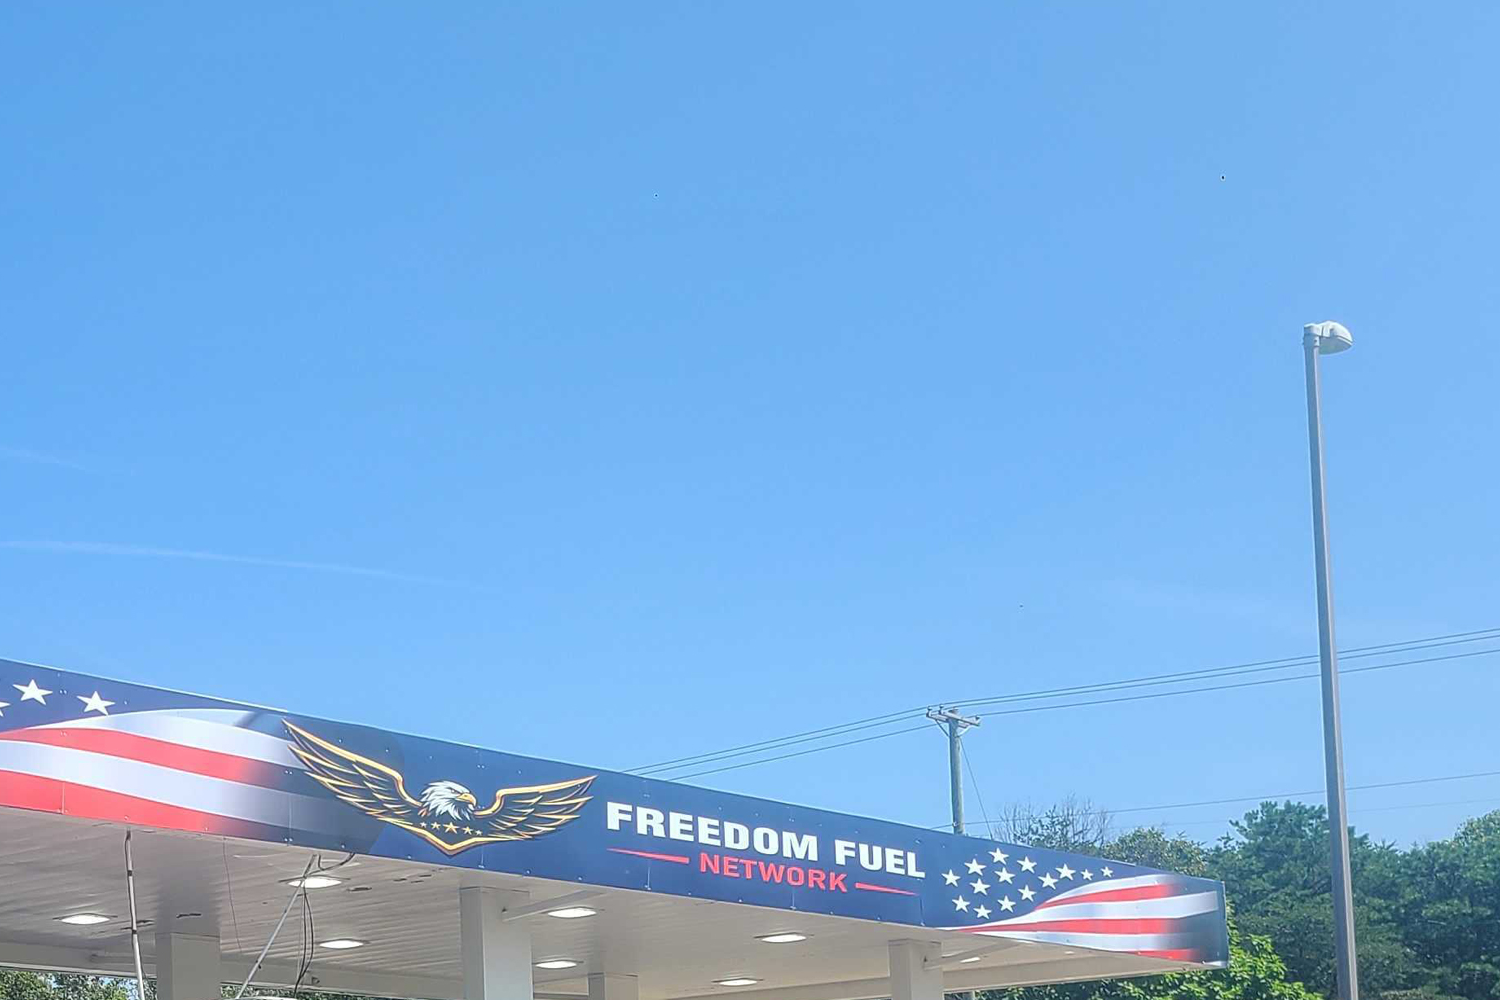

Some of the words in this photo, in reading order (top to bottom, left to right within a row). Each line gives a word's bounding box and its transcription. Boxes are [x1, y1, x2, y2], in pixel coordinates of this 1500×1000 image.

[606, 801, 818, 862] FREEDOM
[835, 839, 926, 879] FUEL
[700, 852, 848, 892] NETWORK
